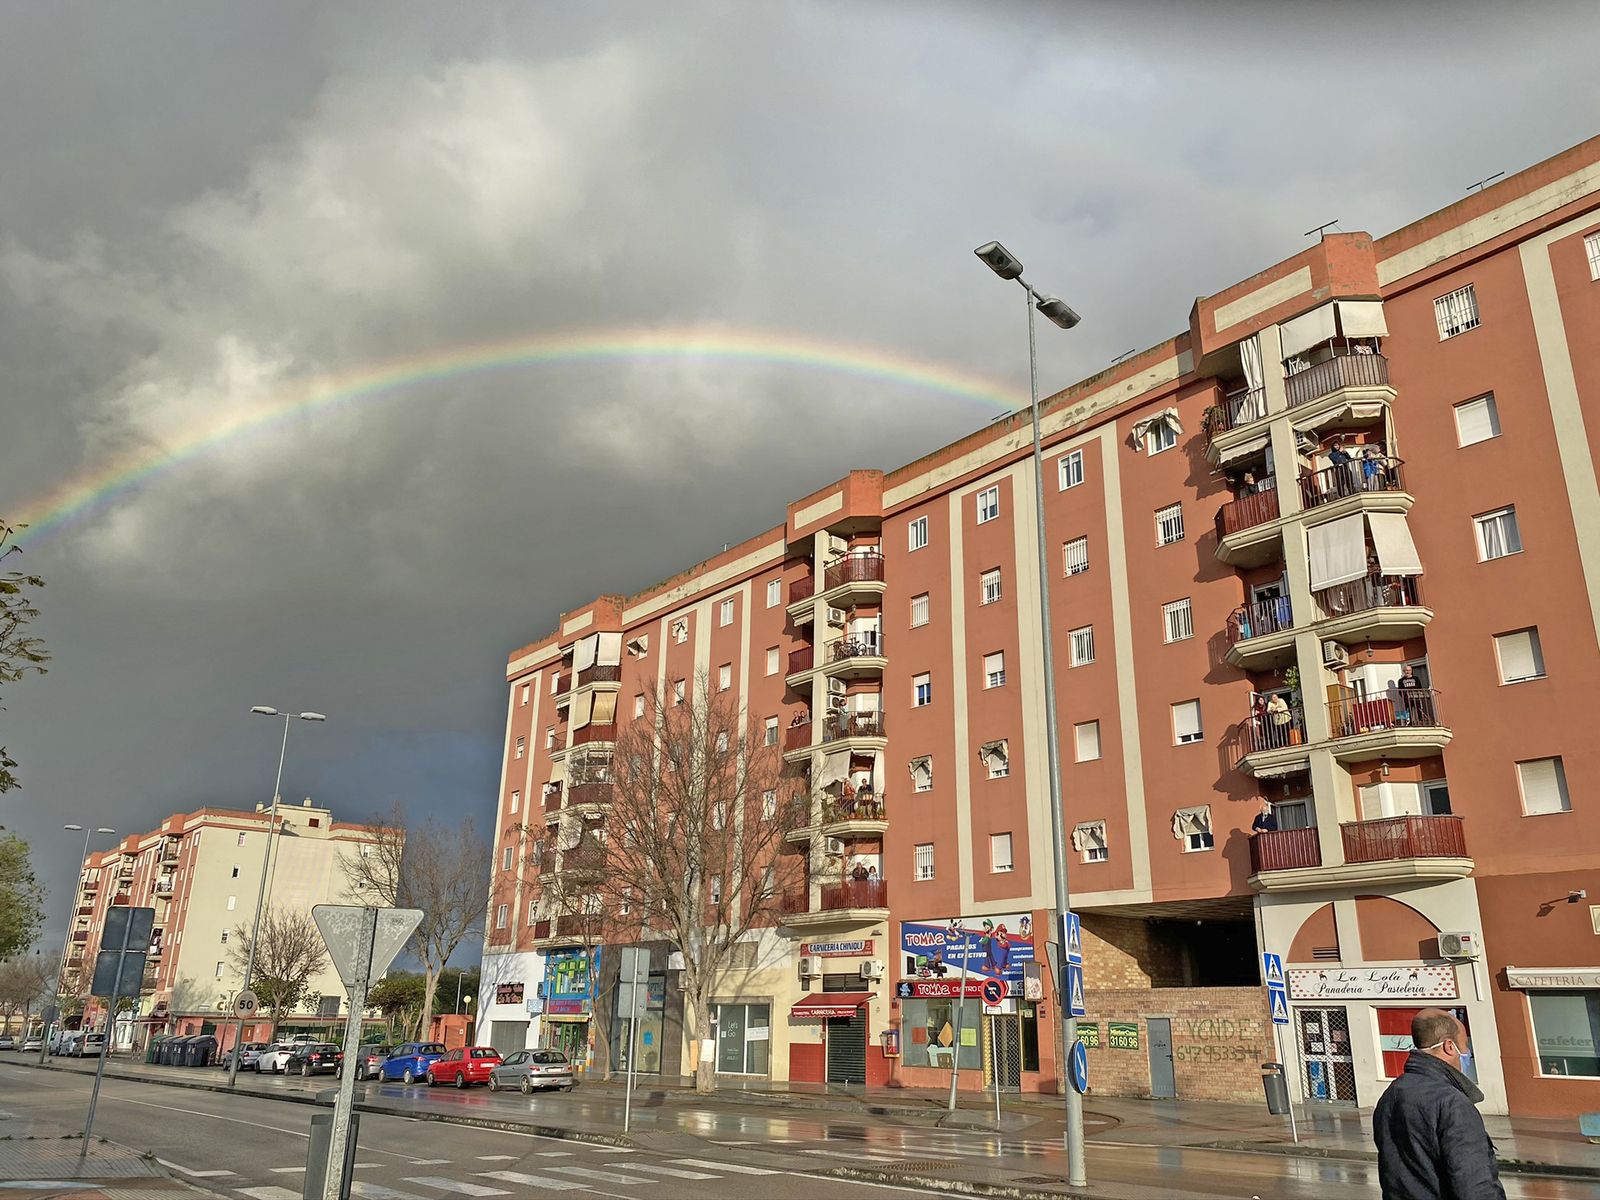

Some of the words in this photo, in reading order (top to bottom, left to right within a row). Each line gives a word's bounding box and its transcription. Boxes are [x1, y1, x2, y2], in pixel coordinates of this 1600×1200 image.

[1334, 971, 1358, 983] La
[1365, 970, 1402, 982] Lola
[1515, 976, 1585, 986] CAFETERIA
[952, 985, 977, 993] CETRO
[239, 1000, 254, 1010] 50
[727, 1029, 737, 1038] Go
